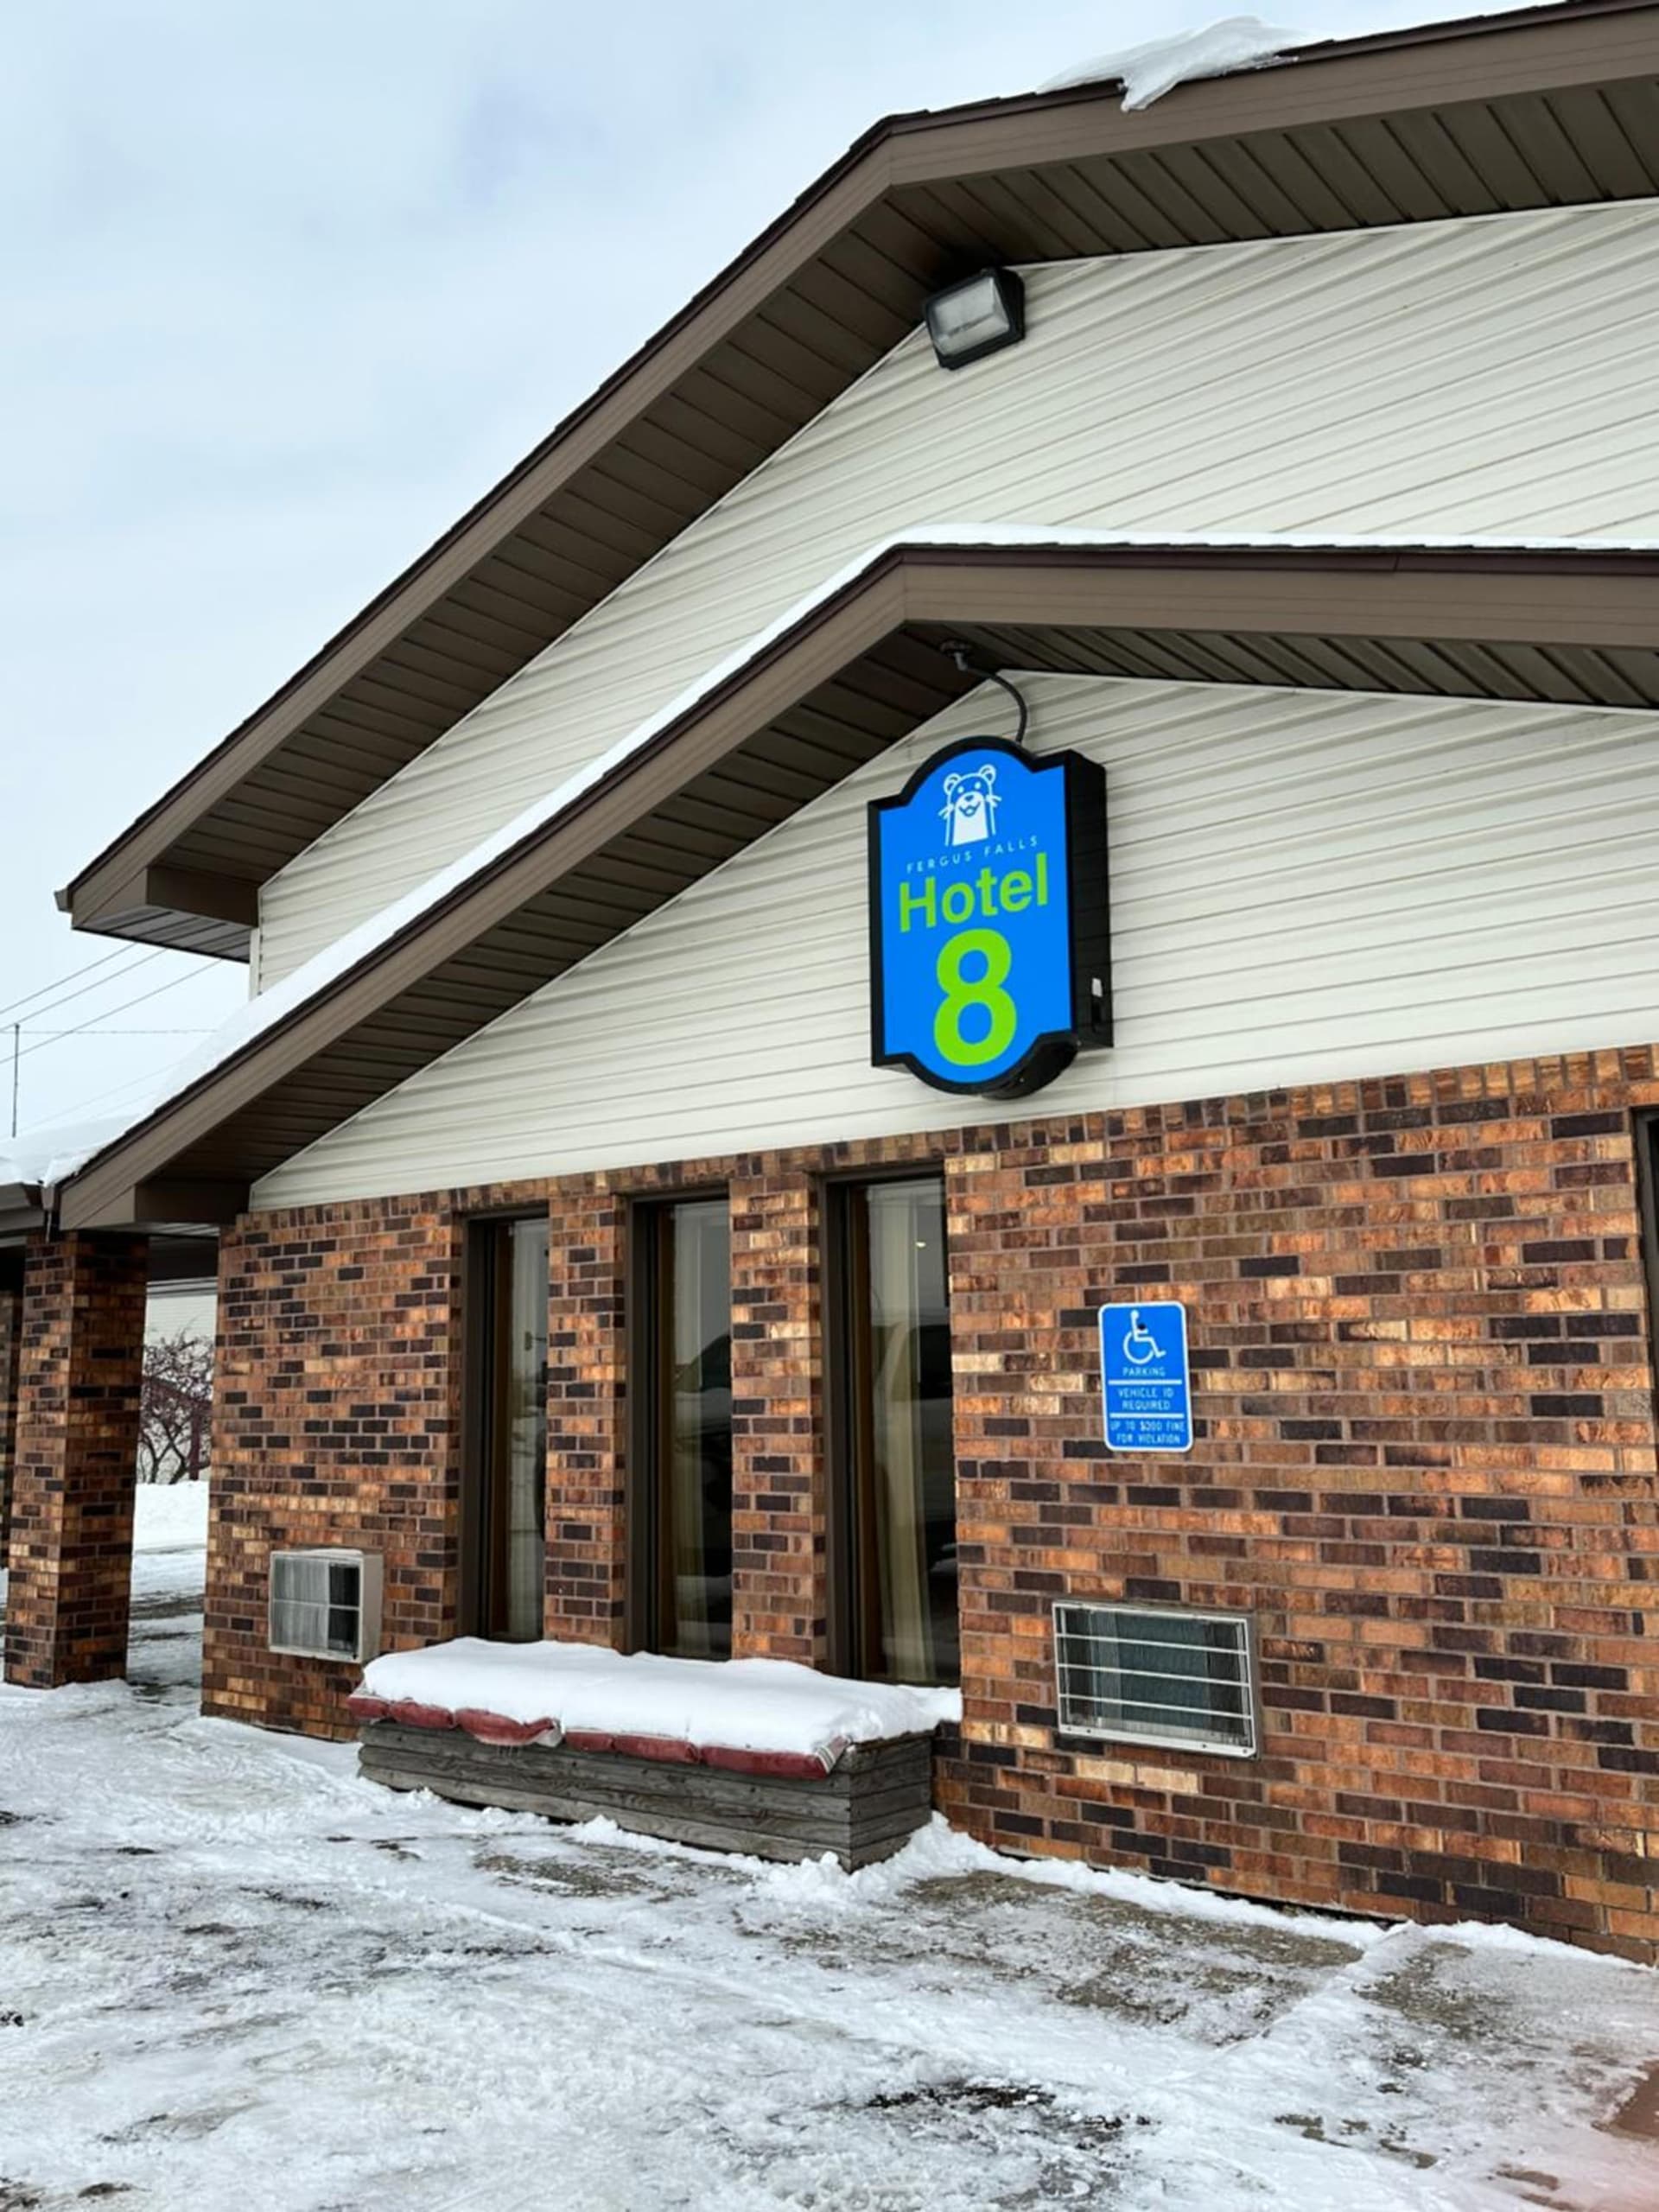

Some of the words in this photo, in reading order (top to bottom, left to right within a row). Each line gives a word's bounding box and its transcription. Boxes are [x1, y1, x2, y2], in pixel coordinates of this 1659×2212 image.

[906, 850, 972, 874] FERGUS
[984, 836, 1037, 856] FALLS
[899, 852, 1047, 933] Hotel
[933, 928, 1017, 1066] 8
[1122, 1366, 1166, 1376] PARKING
[1117, 1387, 1157, 1398] VEHICLE
[1162, 1388, 1174, 1398] ID
[1122, 1400, 1171, 1411] REQUIRED
[1125, 1421, 1135, 1431] TO
[1166, 1421, 1185, 1432] FINE
[1116, 1433, 1133, 1444] FOR
[1138, 1433, 1180, 1444] VIOLATION
